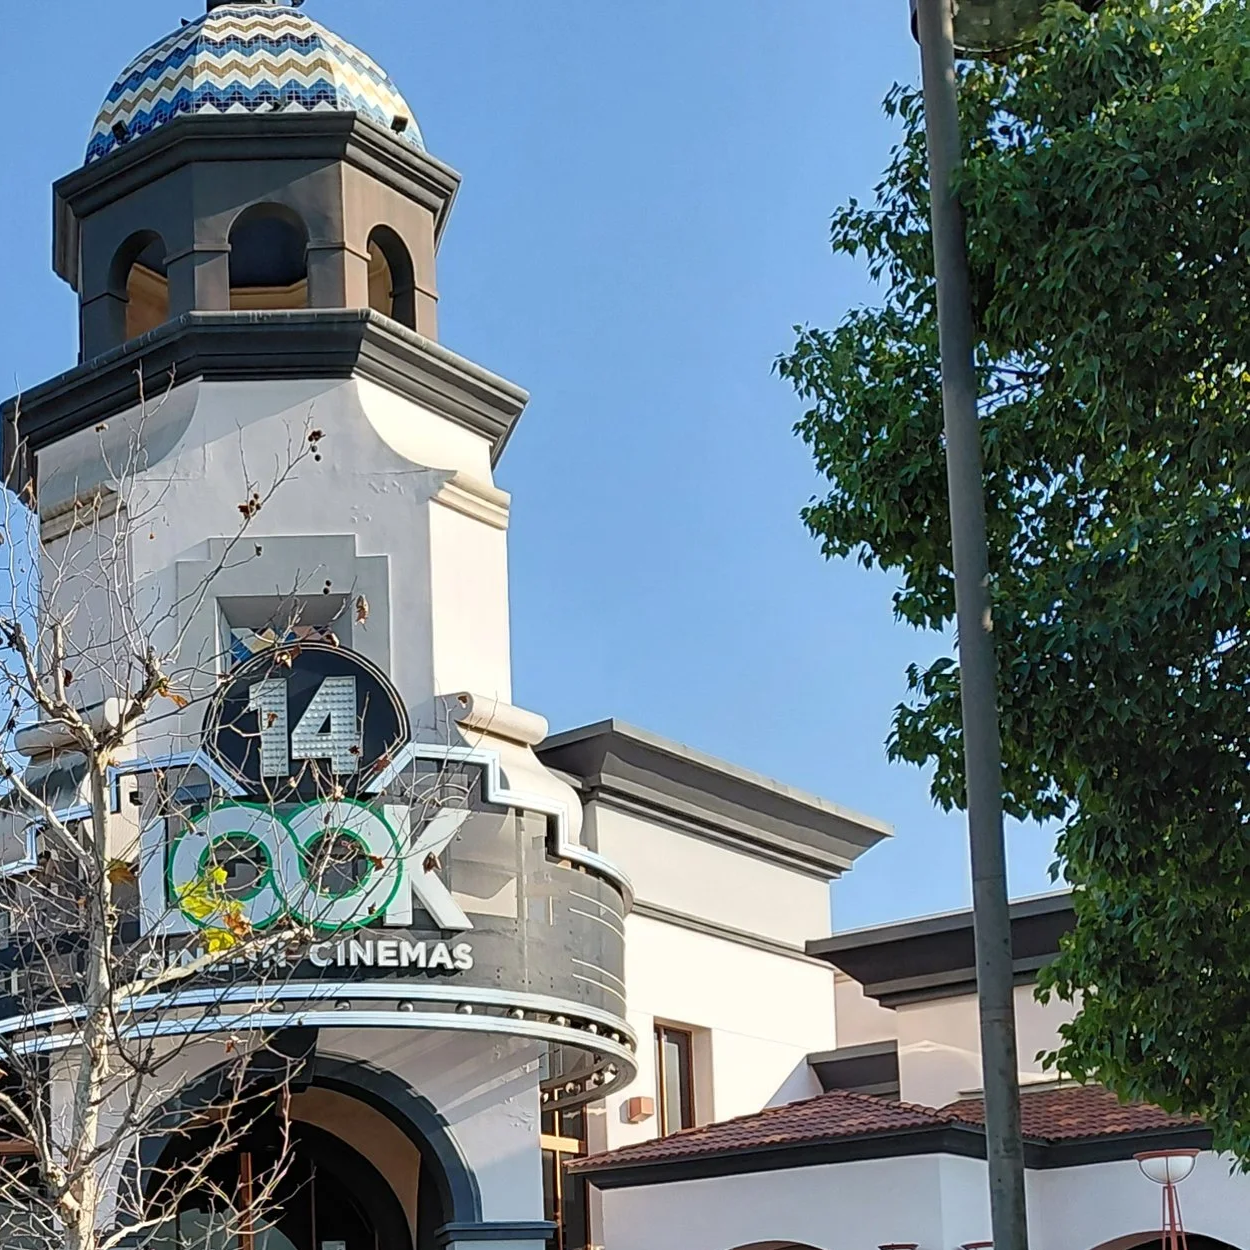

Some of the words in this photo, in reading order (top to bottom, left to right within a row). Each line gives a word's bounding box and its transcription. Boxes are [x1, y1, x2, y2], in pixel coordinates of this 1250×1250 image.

[249, 675, 360, 778] 14
[139, 798, 474, 937] LOOK
[309, 939, 474, 970] CINEMAS
